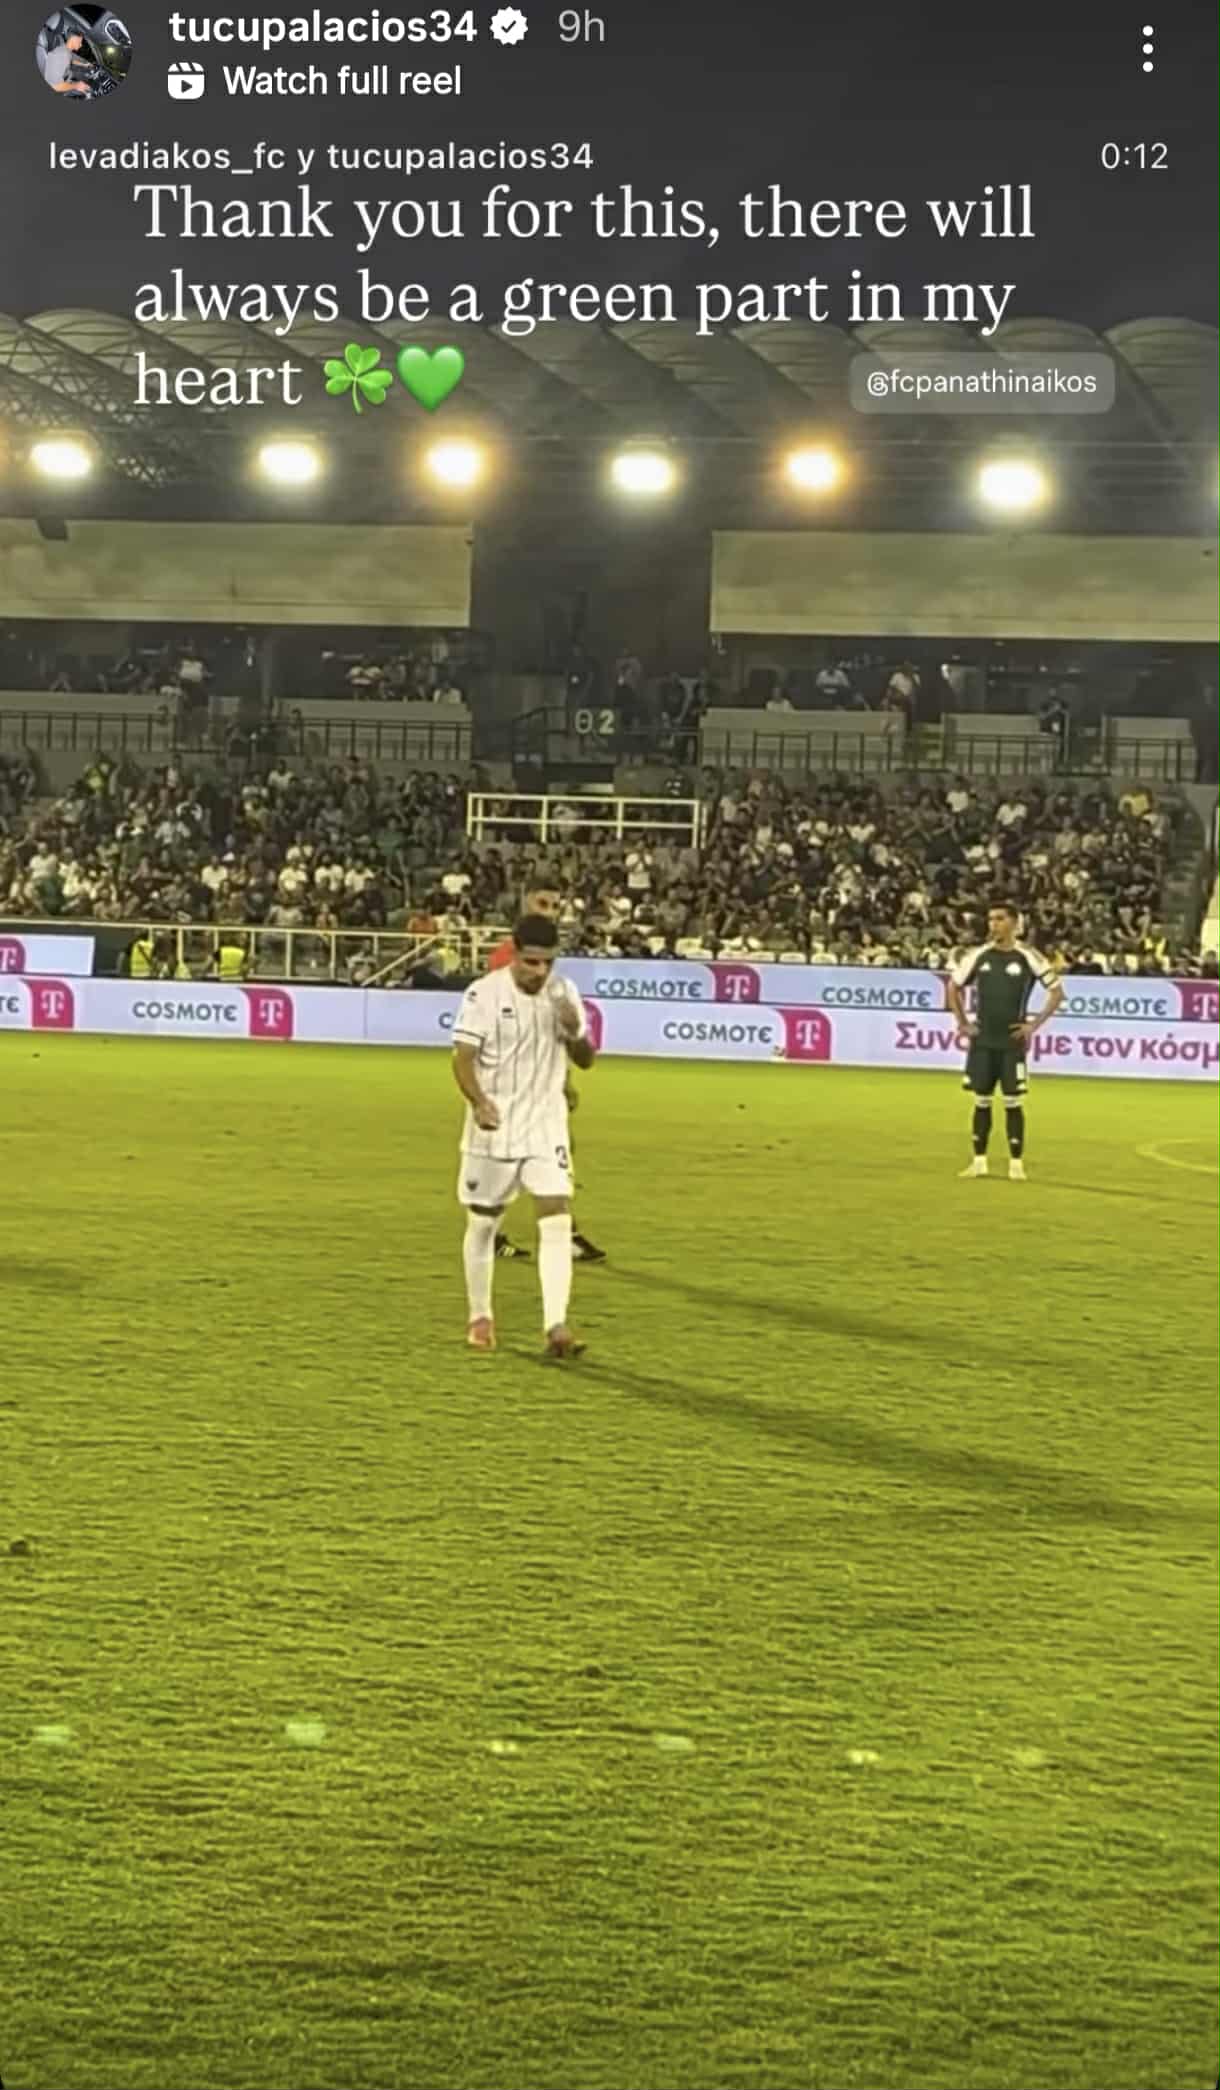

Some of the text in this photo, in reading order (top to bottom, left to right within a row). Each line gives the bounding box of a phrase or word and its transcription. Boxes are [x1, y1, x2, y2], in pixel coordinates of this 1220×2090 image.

[595, 979, 702, 998] COSMOTE
[822, 987, 931, 1007] COSMOTE
[132, 1001, 238, 1022] COSMOTE
[663, 1021, 772, 1043] COSMOTE
[1077, 1035, 1134, 1059] τον
